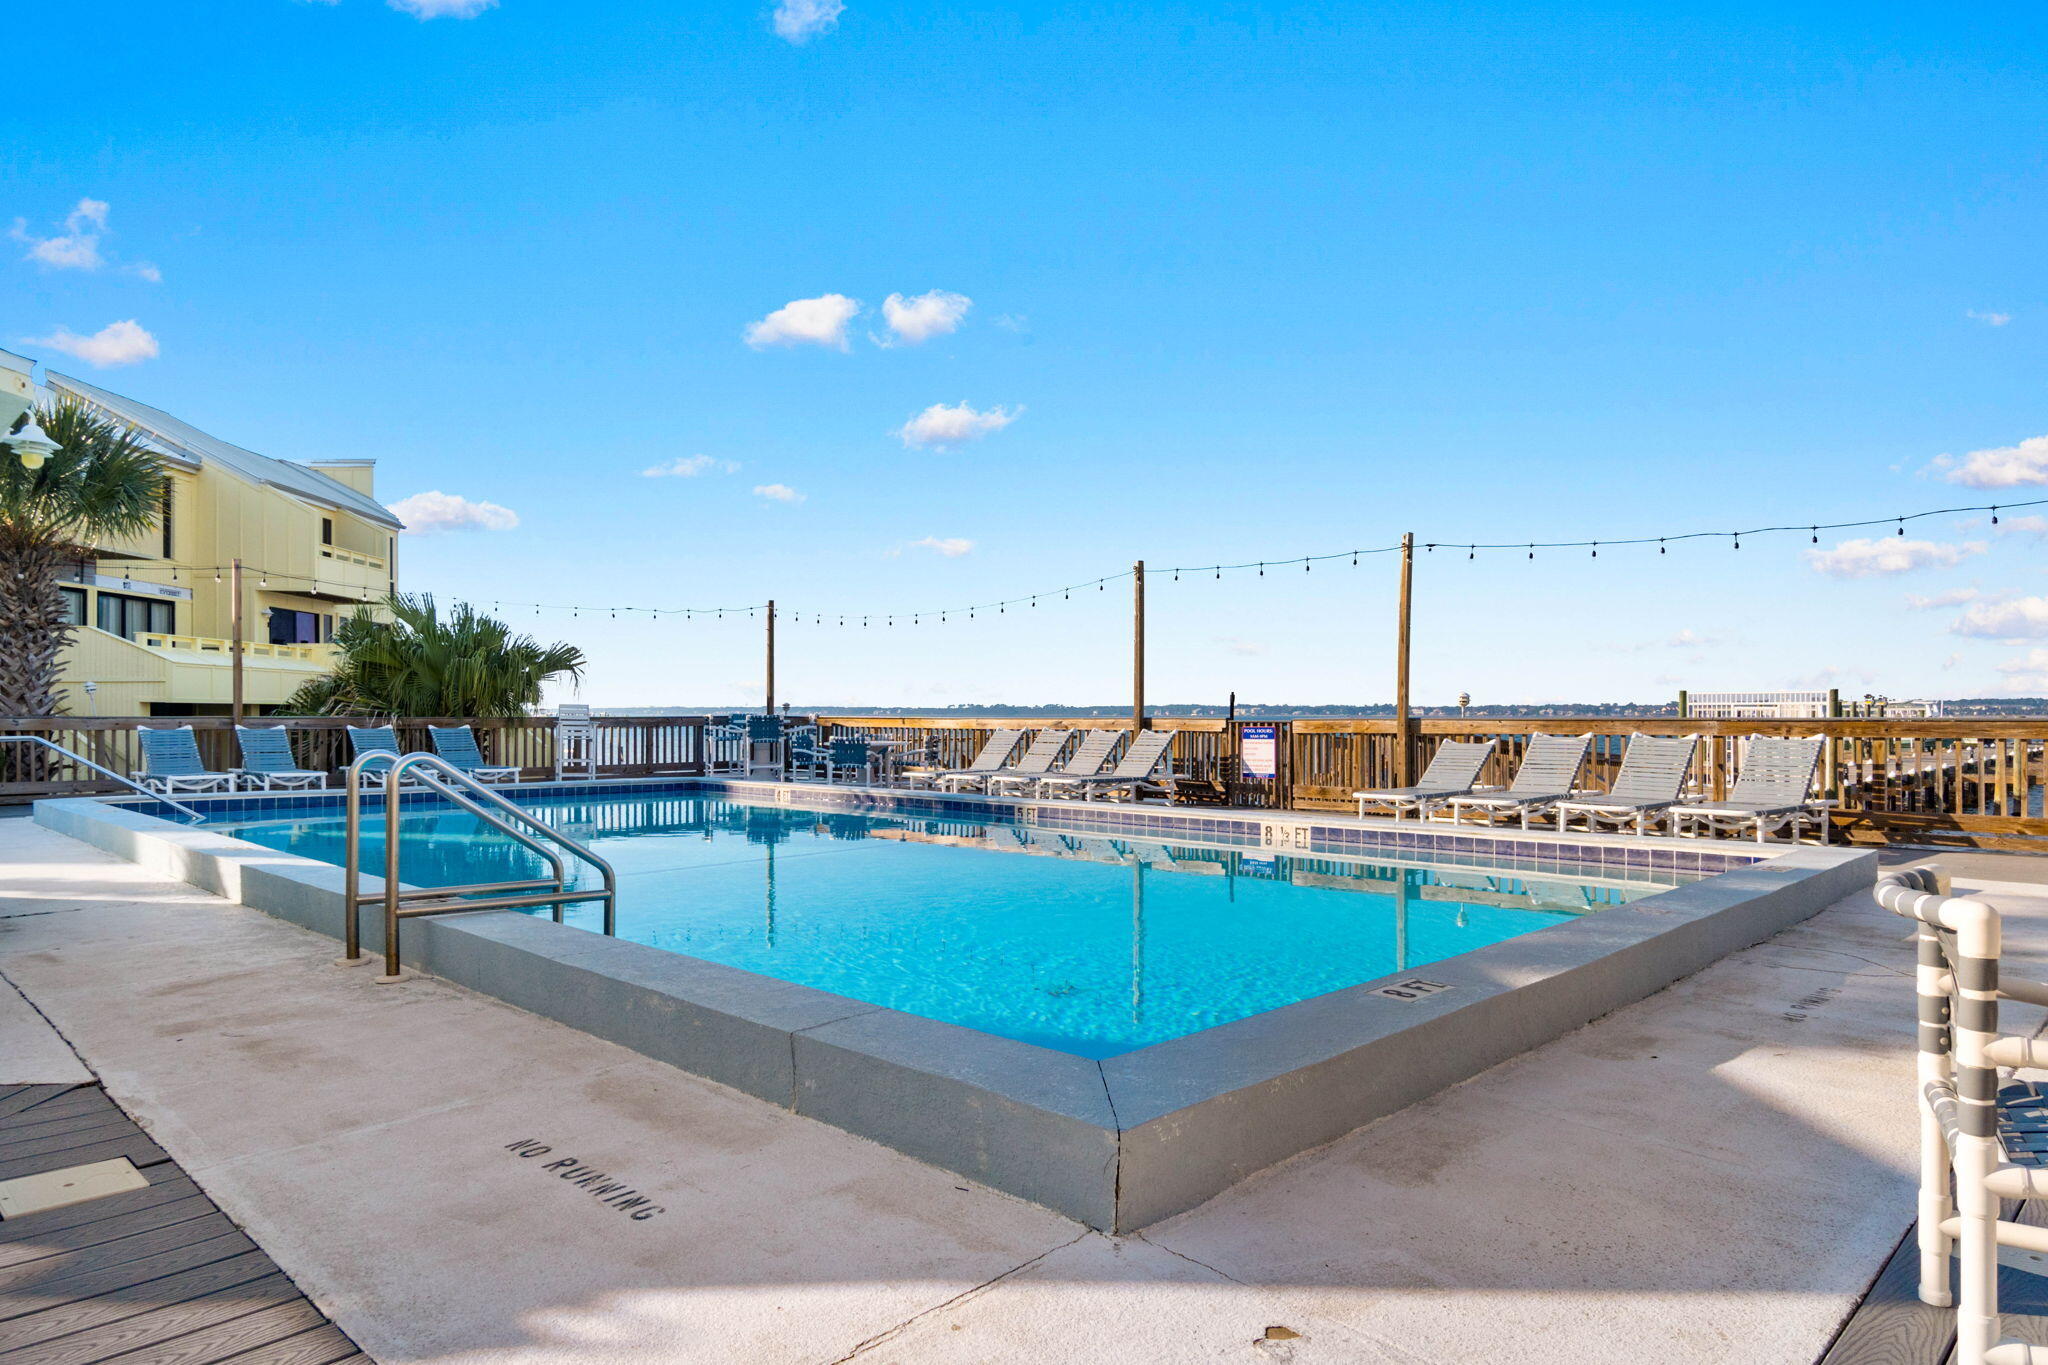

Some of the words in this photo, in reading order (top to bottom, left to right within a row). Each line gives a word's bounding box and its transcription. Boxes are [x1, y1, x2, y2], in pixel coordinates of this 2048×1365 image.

[1026, 807, 1036, 819] FT
[1295, 827, 1309, 840] FT
[1399, 980, 1447, 992] FT
[1382, 989, 1417, 998] 8
[504, 1138, 552, 1158] NO
[541, 1157, 666, 1221] RUNNING
